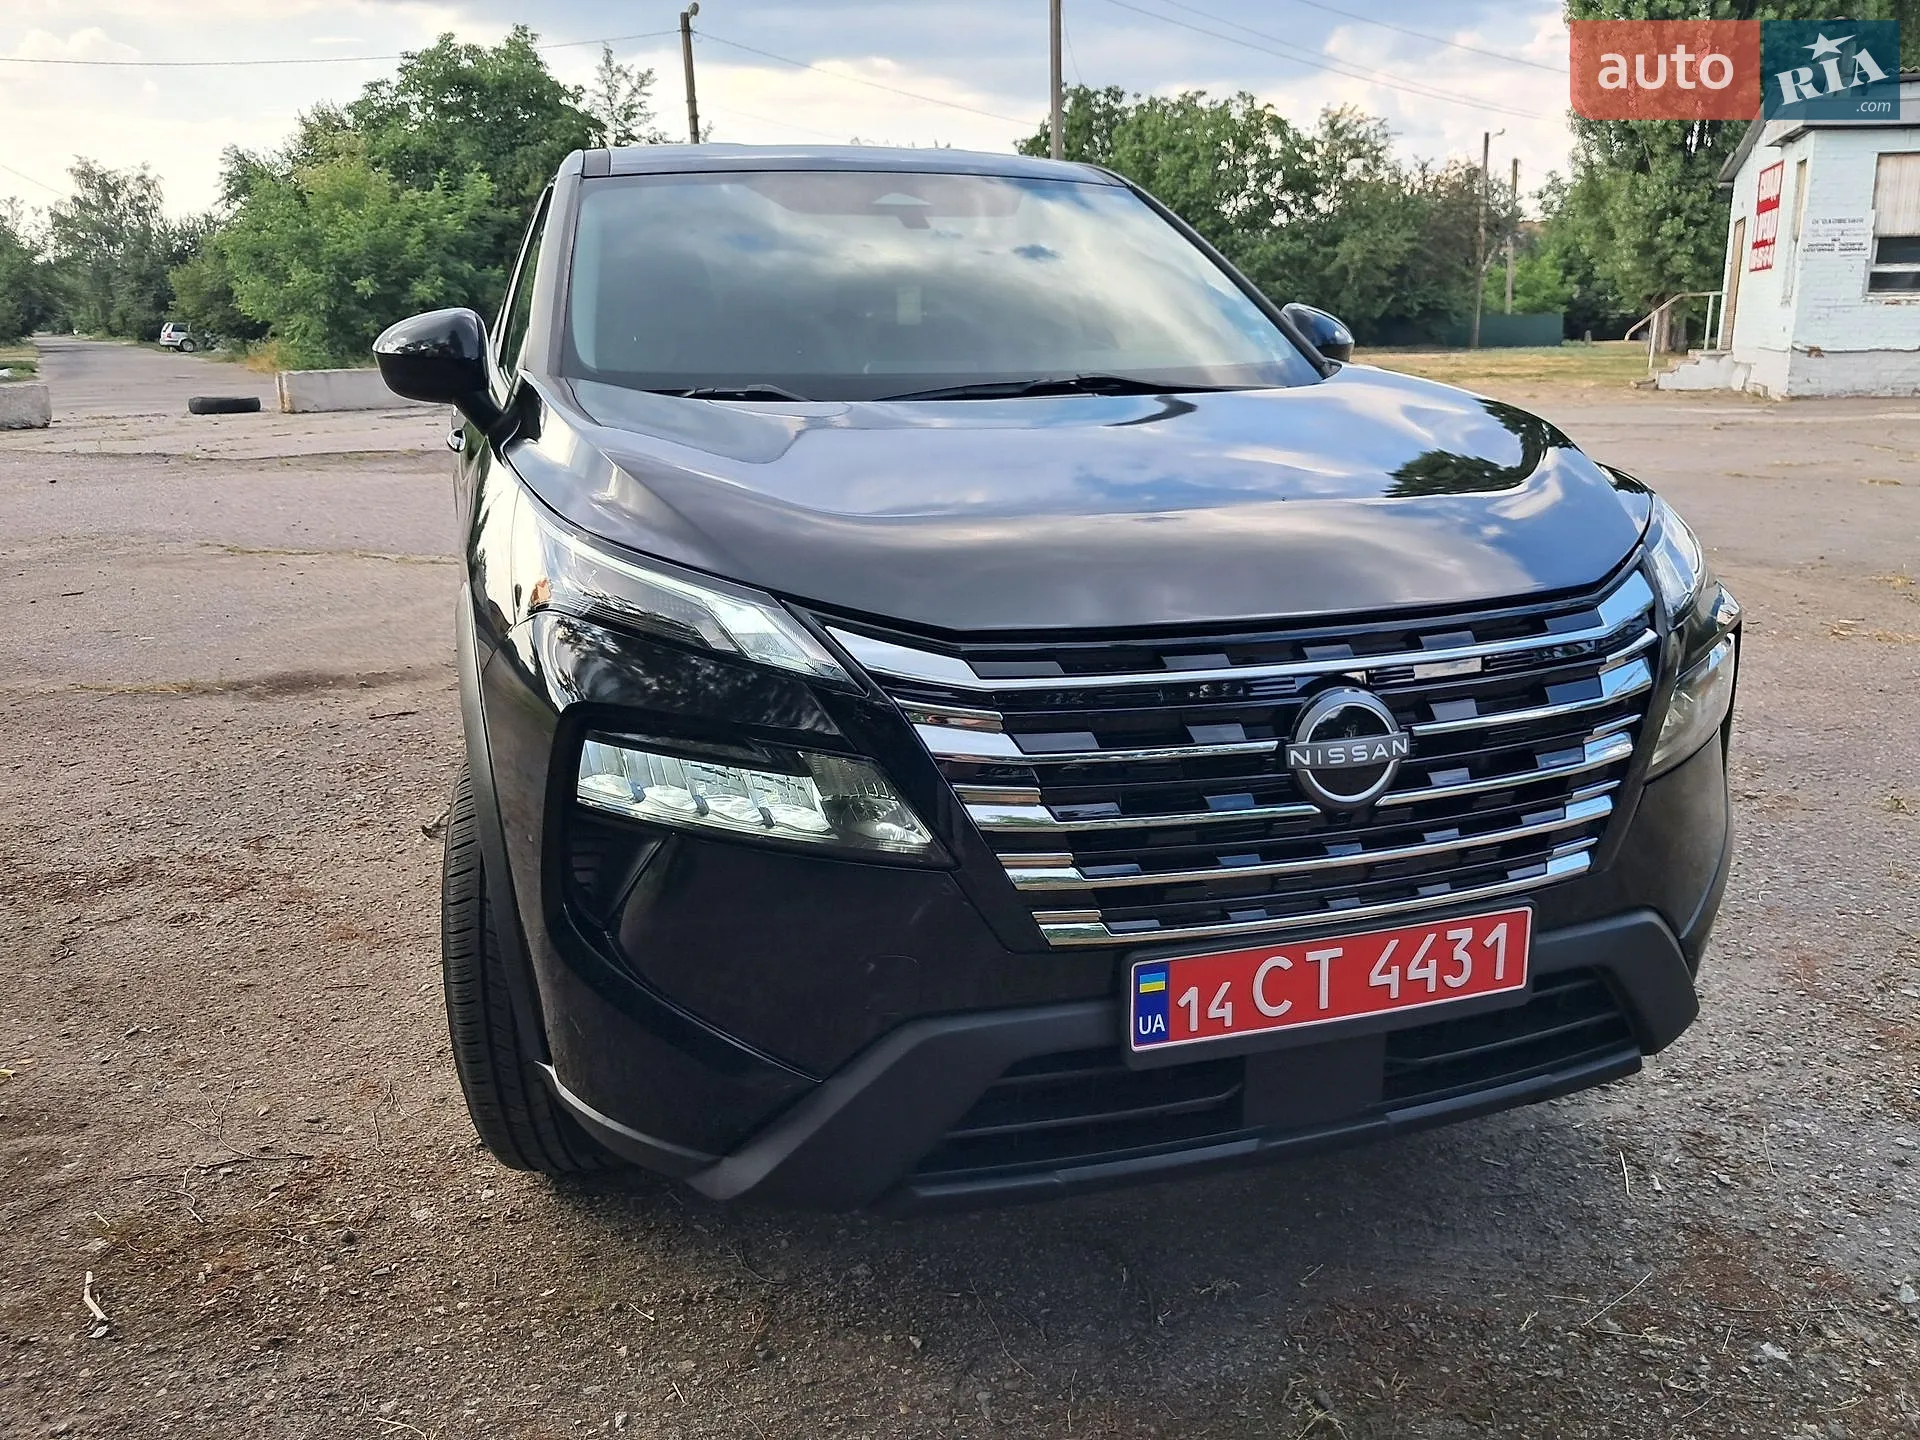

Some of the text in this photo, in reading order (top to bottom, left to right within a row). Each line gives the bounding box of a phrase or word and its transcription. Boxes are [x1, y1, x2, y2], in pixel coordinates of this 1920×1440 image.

[1289, 738, 1408, 766] NISSAN
[1178, 922, 1508, 1032] 14 CT 4431
[1139, 1016, 1166, 1034] UA
